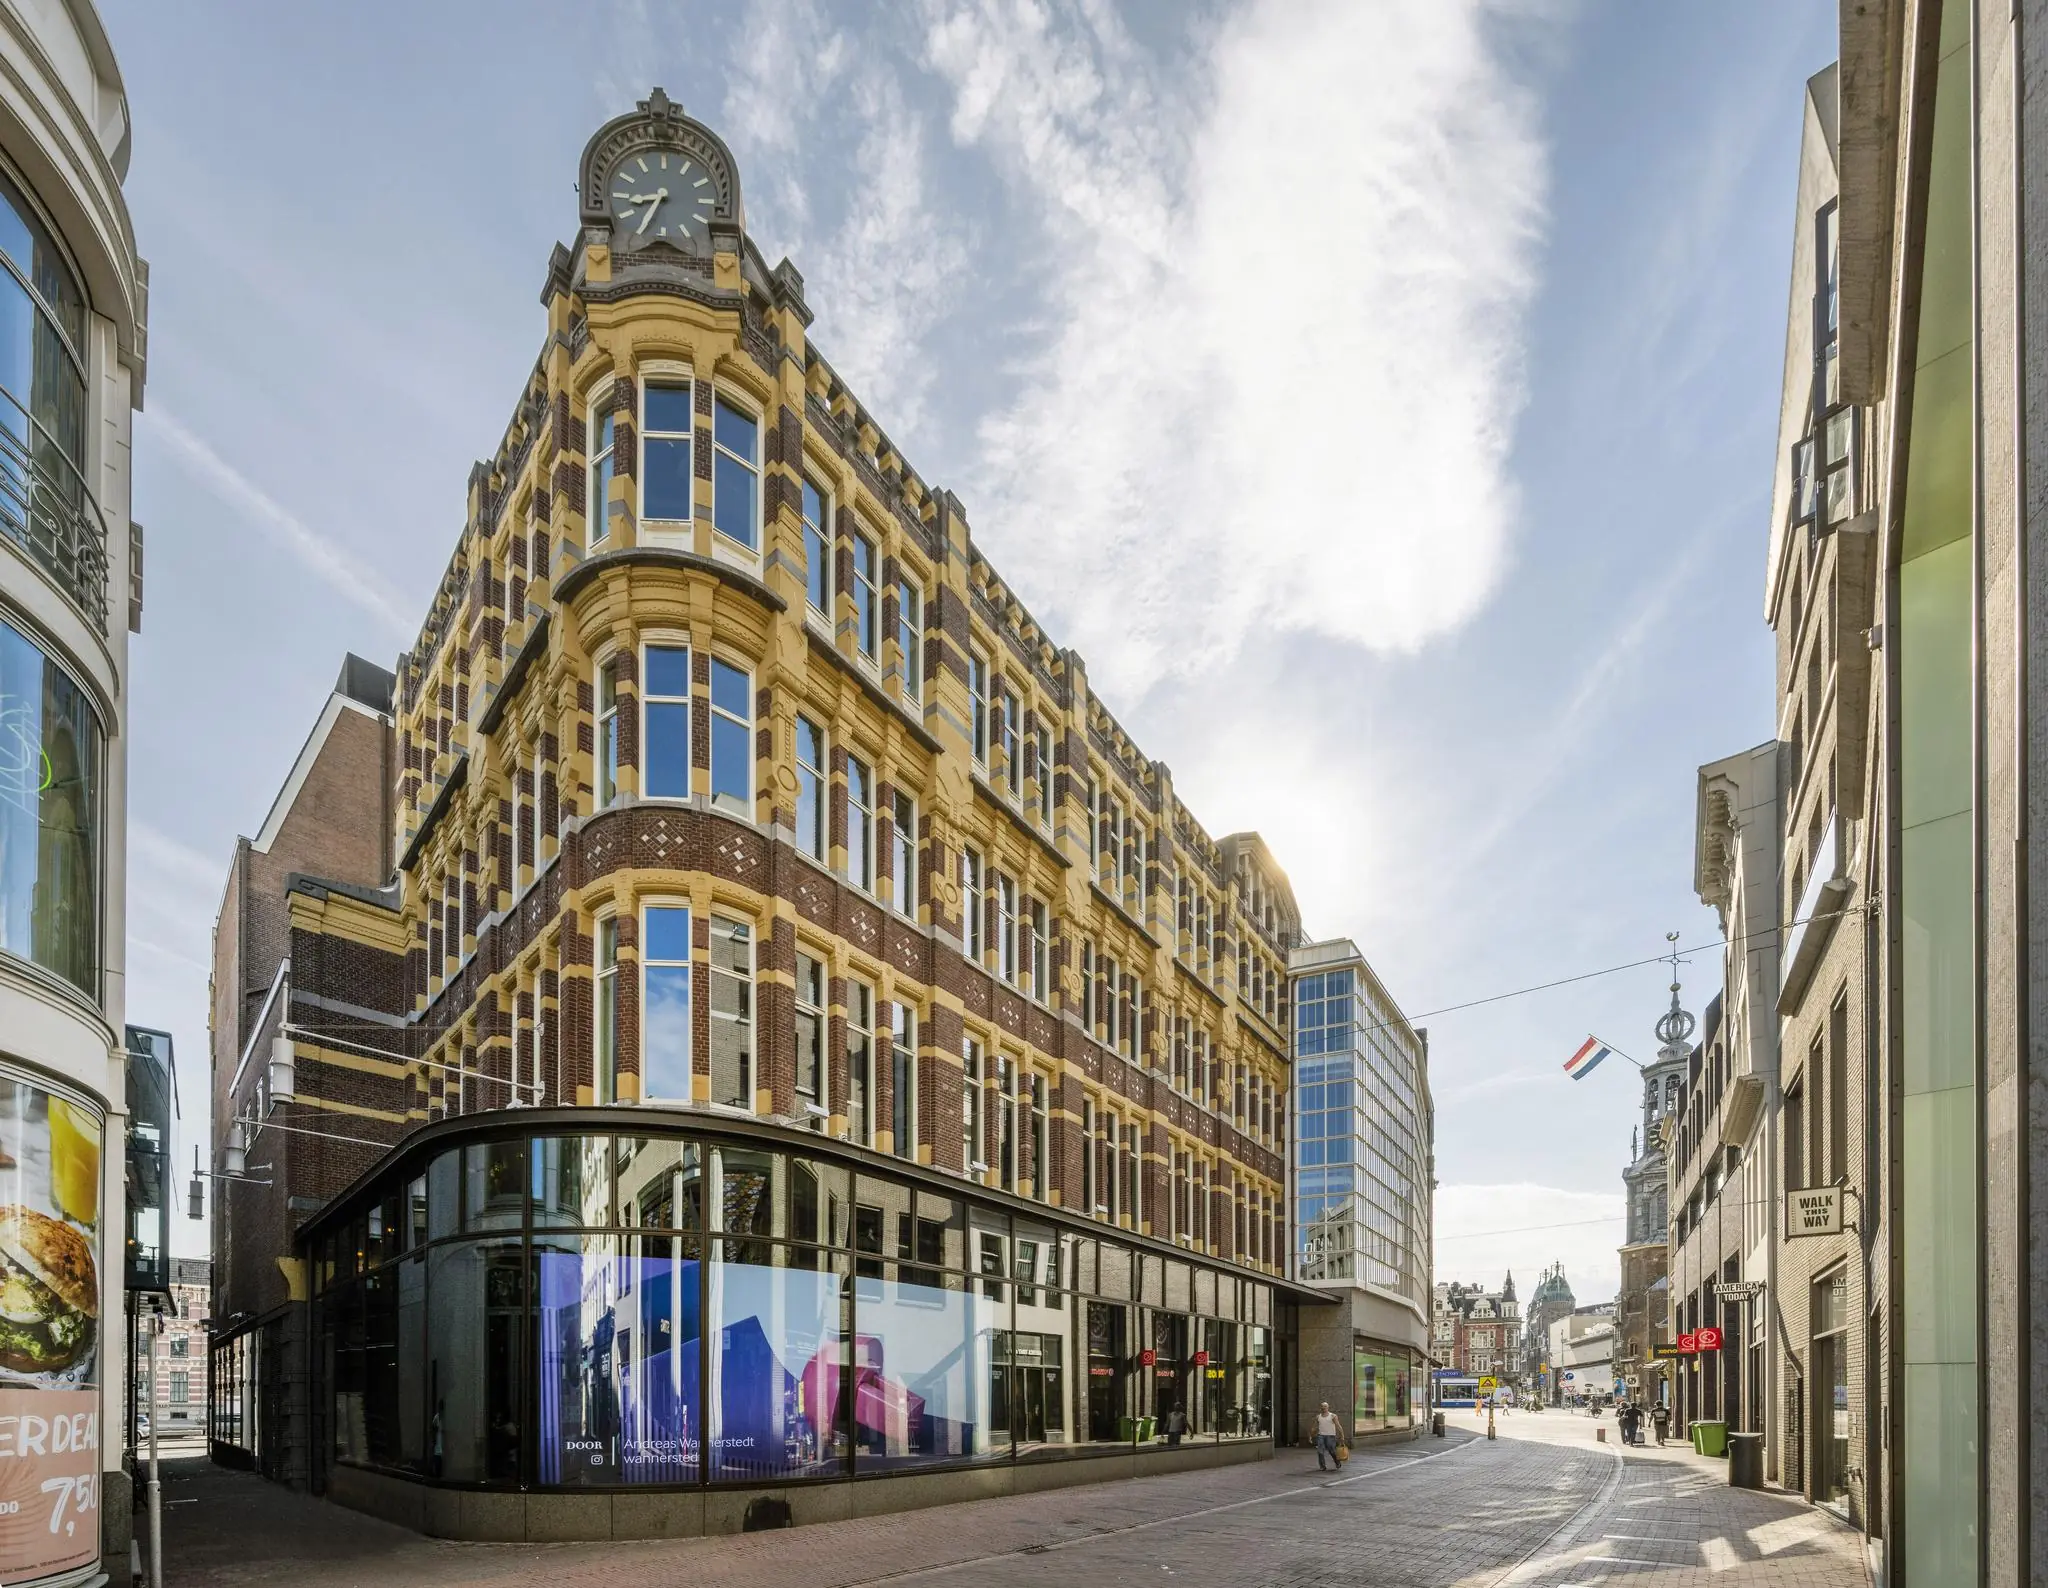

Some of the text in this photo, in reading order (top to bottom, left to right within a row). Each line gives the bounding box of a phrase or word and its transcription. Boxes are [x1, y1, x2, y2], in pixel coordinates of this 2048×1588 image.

[1799, 1195, 1833, 1209] WALK
[1803, 1215, 1830, 1228] WAY
[1715, 1282, 1757, 1292] AMERICA
[1723, 1292, 1749, 1301] TODAY
[566, 1441, 603, 1450] DOOR
[623, 1438, 677, 1449] Andreas
[40, 1474, 98, 1537] 7,50
